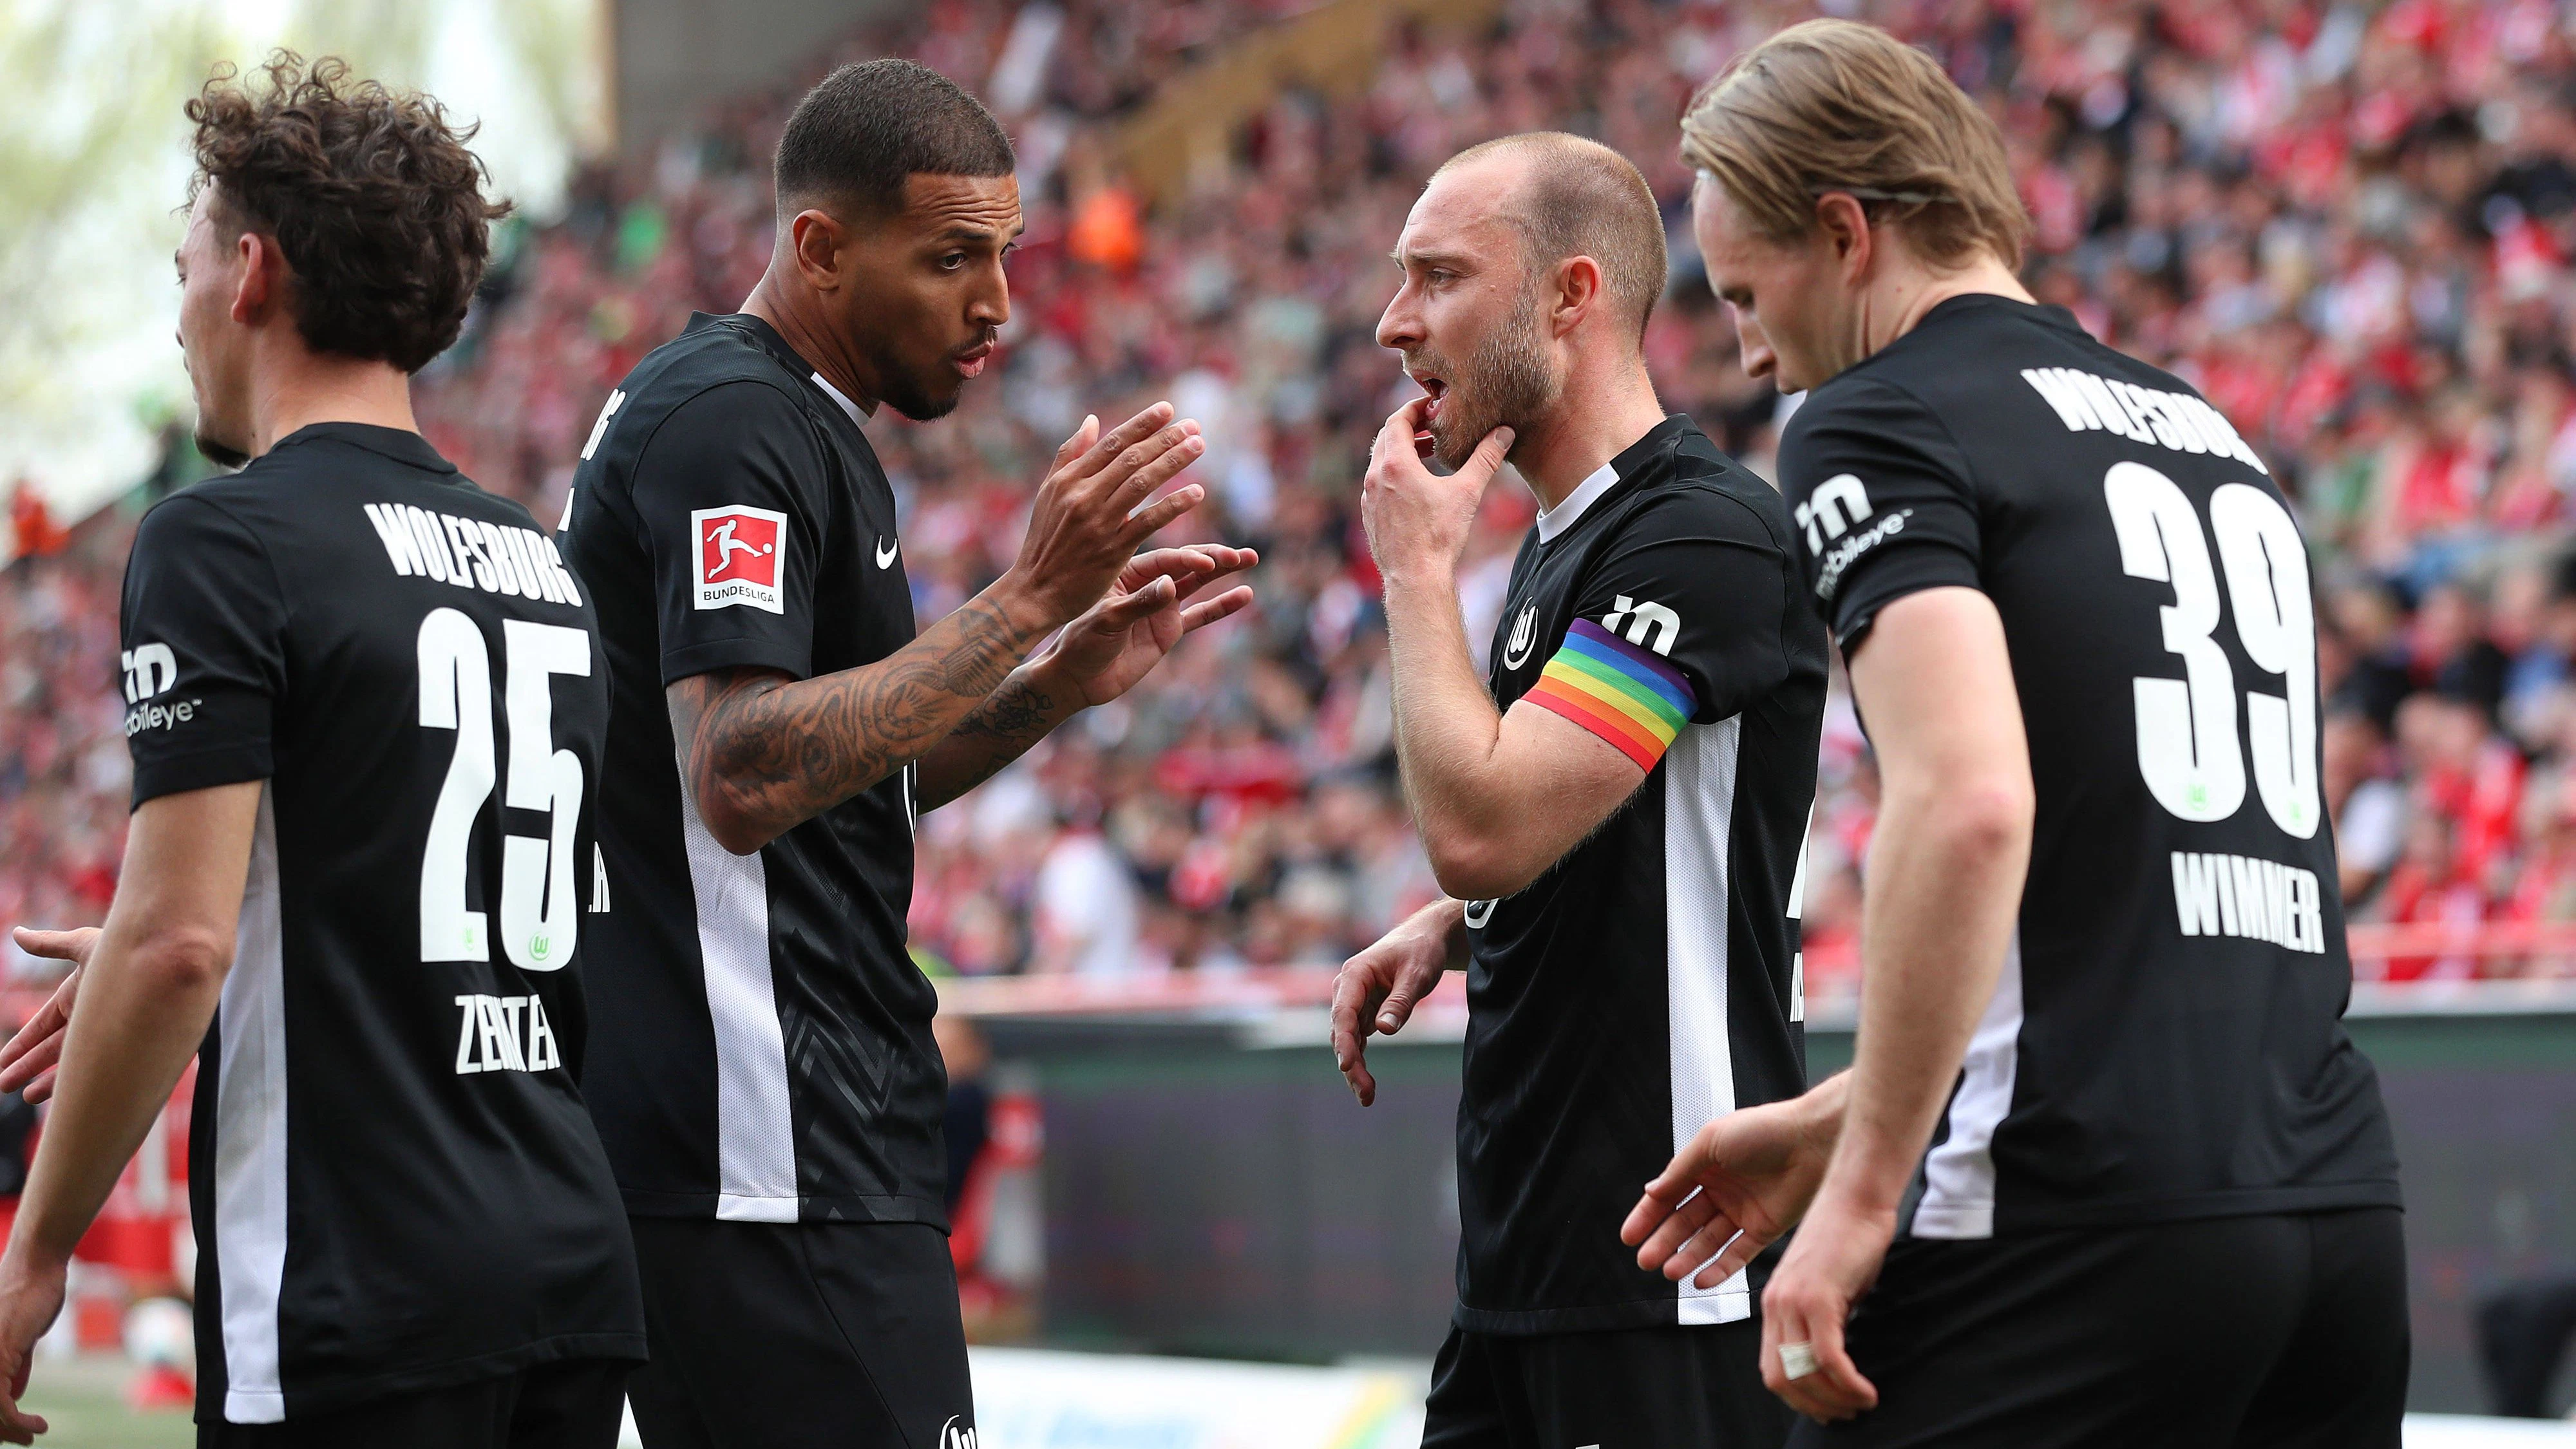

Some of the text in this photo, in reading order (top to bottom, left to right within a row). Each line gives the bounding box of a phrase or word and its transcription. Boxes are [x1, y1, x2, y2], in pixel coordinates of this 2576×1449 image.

[363, 503, 583, 607] WOLFSBURG
[704, 585, 774, 604] BUNDESLIGA
[2103, 461, 2322, 840] 39
[125, 701, 194, 737] obileye
[417, 607, 591, 972] 25
